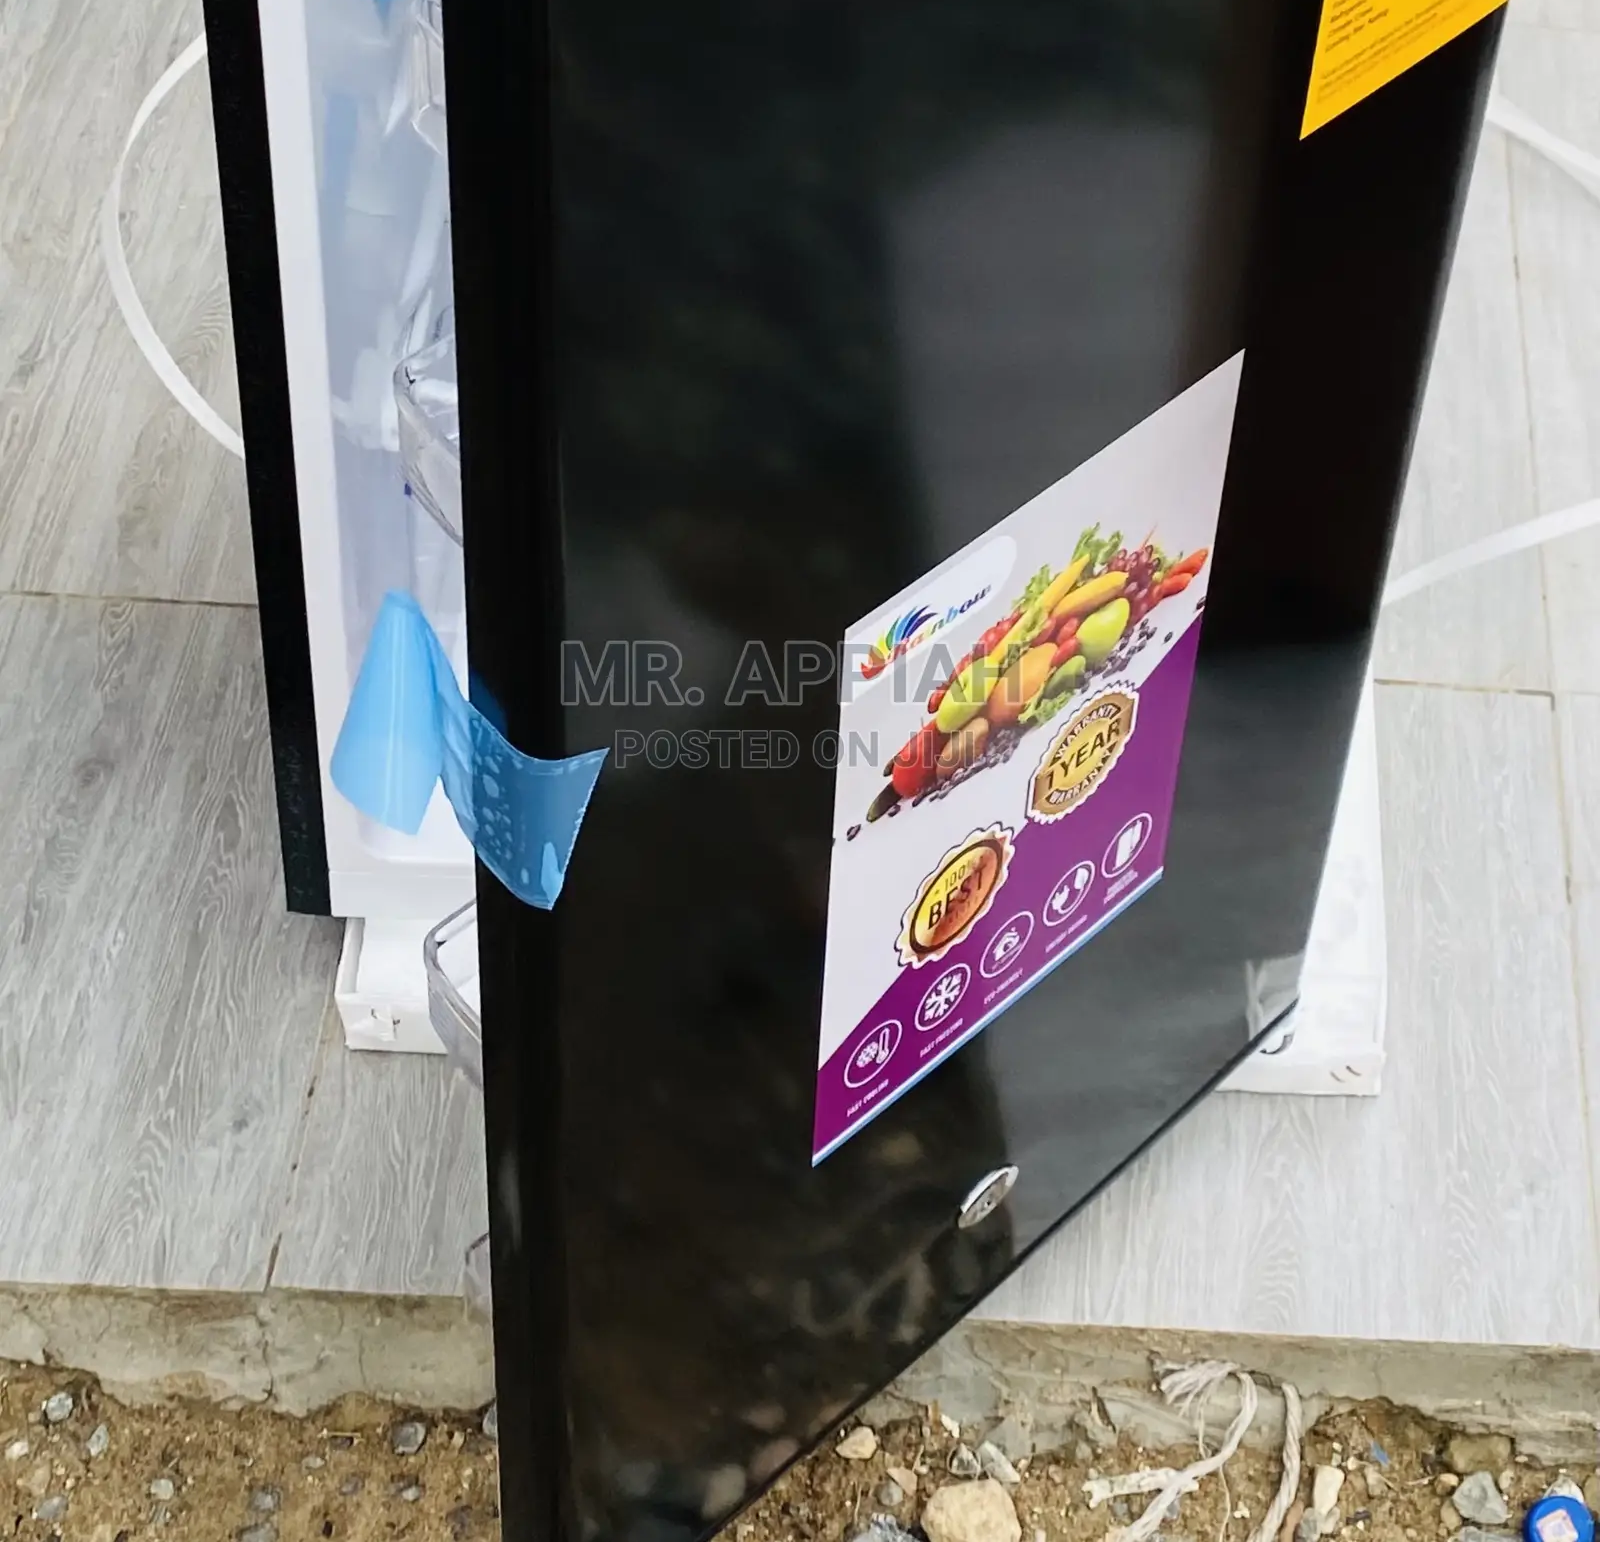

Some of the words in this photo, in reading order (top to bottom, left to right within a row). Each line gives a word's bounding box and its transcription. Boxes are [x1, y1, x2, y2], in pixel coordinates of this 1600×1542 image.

[1046, 770, 1055, 790] 1
[1060, 718, 1122, 777] YEAR
[1055, 705, 1118, 758] WARRANTY
[928, 861, 989, 930] BEST
